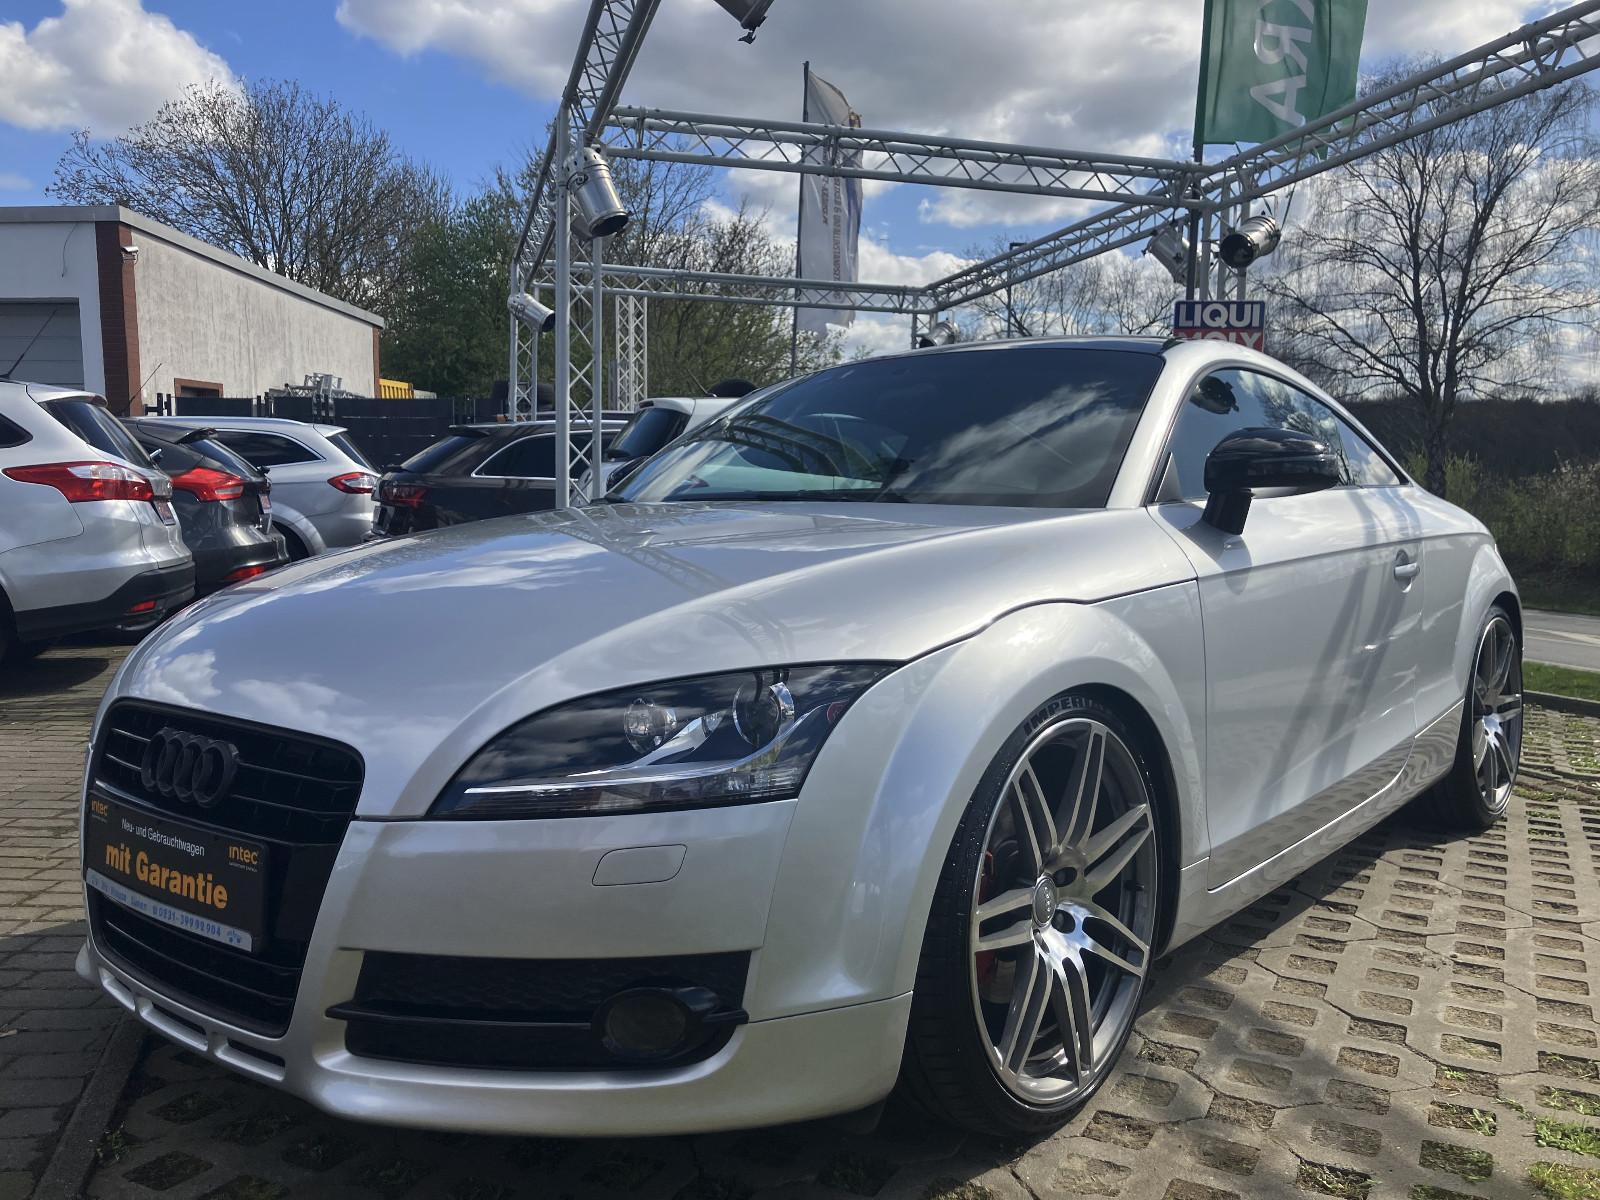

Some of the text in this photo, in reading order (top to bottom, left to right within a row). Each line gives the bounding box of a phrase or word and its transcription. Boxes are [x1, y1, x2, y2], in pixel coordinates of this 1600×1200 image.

[1178, 303, 1261, 329] LIQUI
[121, 818, 135, 833] Neu-
[136, 825, 147, 838] und
[147, 828, 205, 857] Gebrauchtwagen
[228, 846, 258, 865] intec
[105, 843, 131, 875] mit
[136, 851, 228, 909] Garantie
